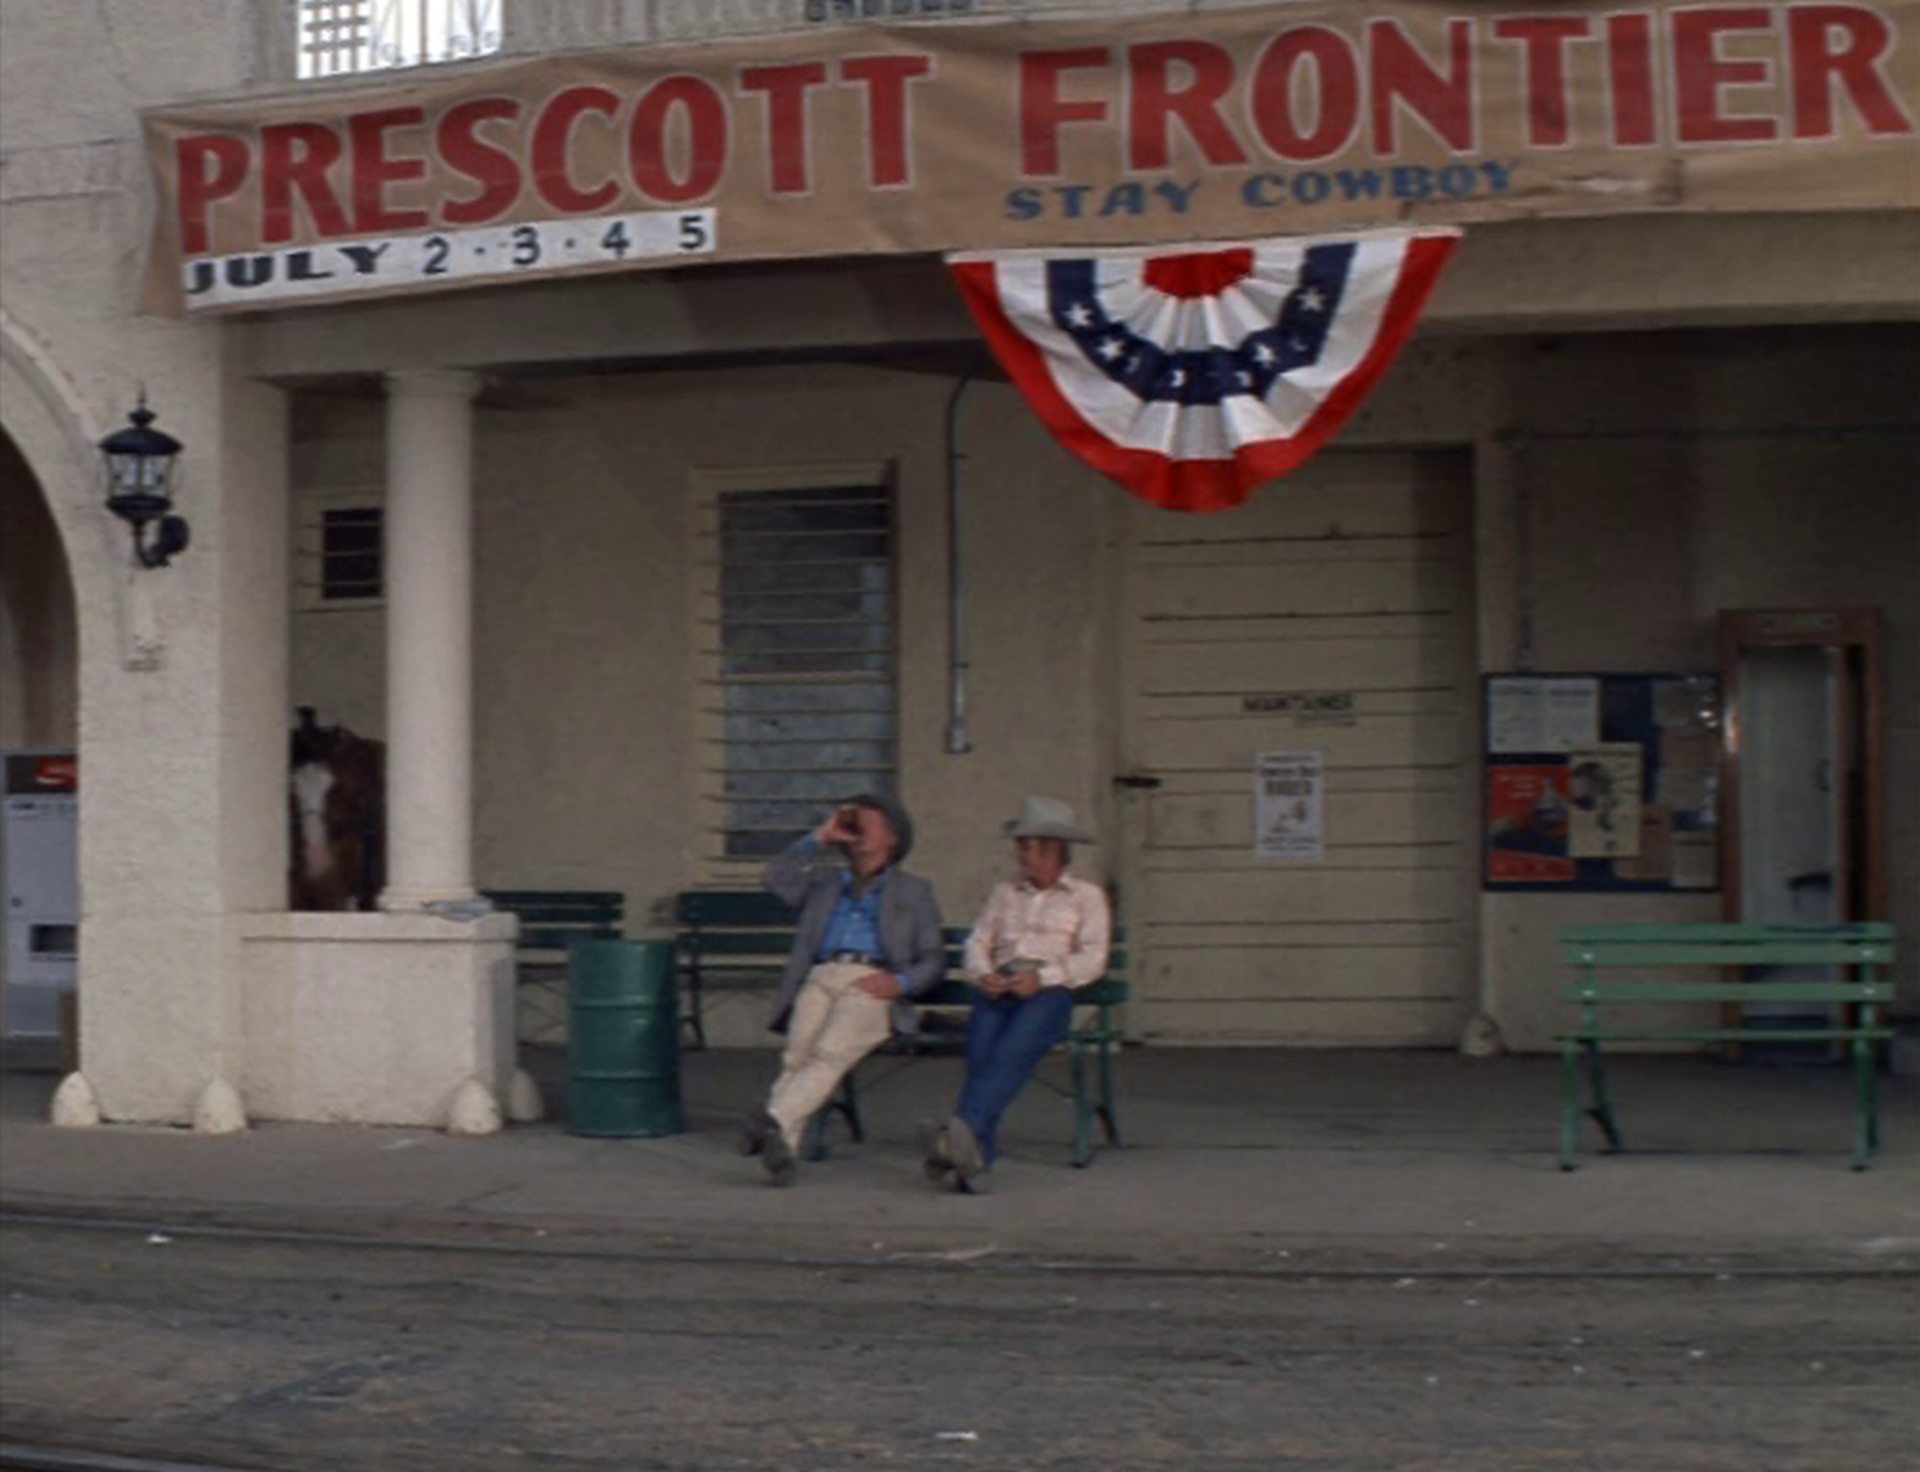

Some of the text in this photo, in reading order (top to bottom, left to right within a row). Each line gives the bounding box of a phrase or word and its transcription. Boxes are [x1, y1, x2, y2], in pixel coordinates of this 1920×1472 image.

[176, 5, 1911, 254] PRESCOTT FRONTIER
[1005, 159, 1519, 221] STAY COWBOY
[185, 243, 389, 295] JULY
[680, 215, 706, 250] 5
